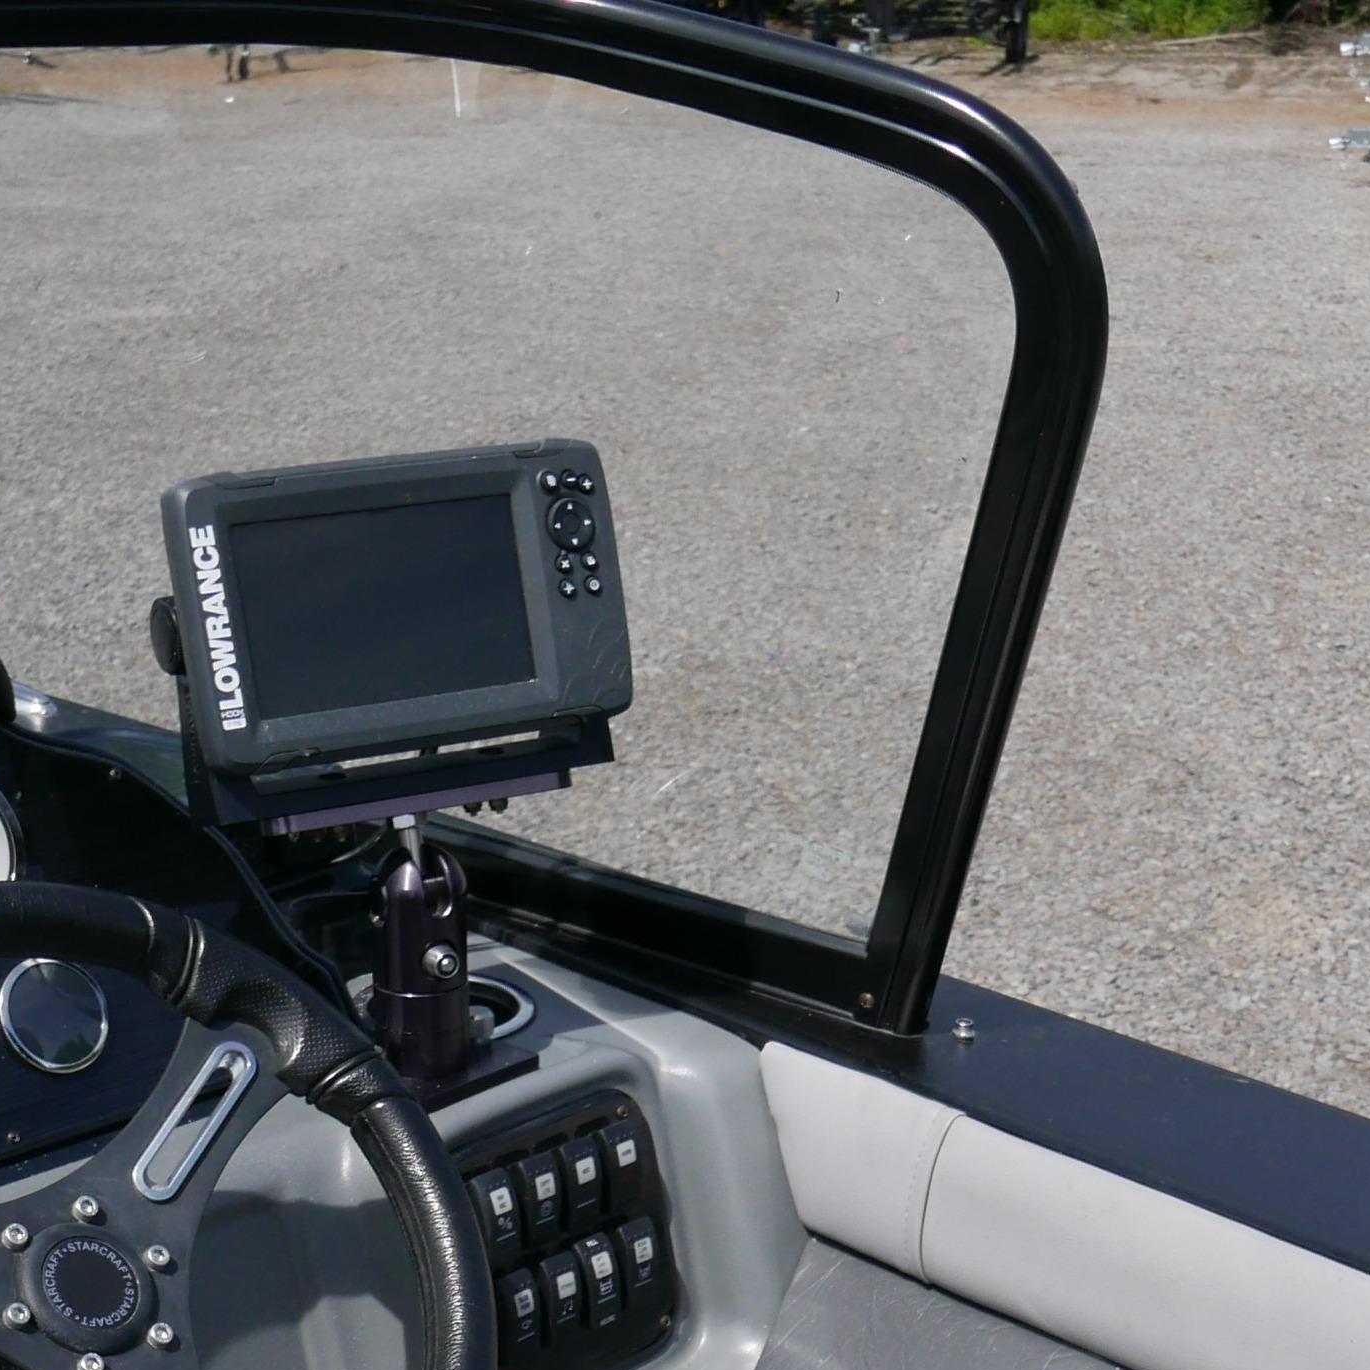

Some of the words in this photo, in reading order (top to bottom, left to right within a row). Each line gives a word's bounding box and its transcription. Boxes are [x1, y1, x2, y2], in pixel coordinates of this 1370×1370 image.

[189, 524, 244, 710] LOWRANCE
[45, 1249, 73, 1317] STARCRAFT
[67, 1241, 133, 1280] STARCRAFT
[80, 1287, 135, 1328] STARCRAFT
